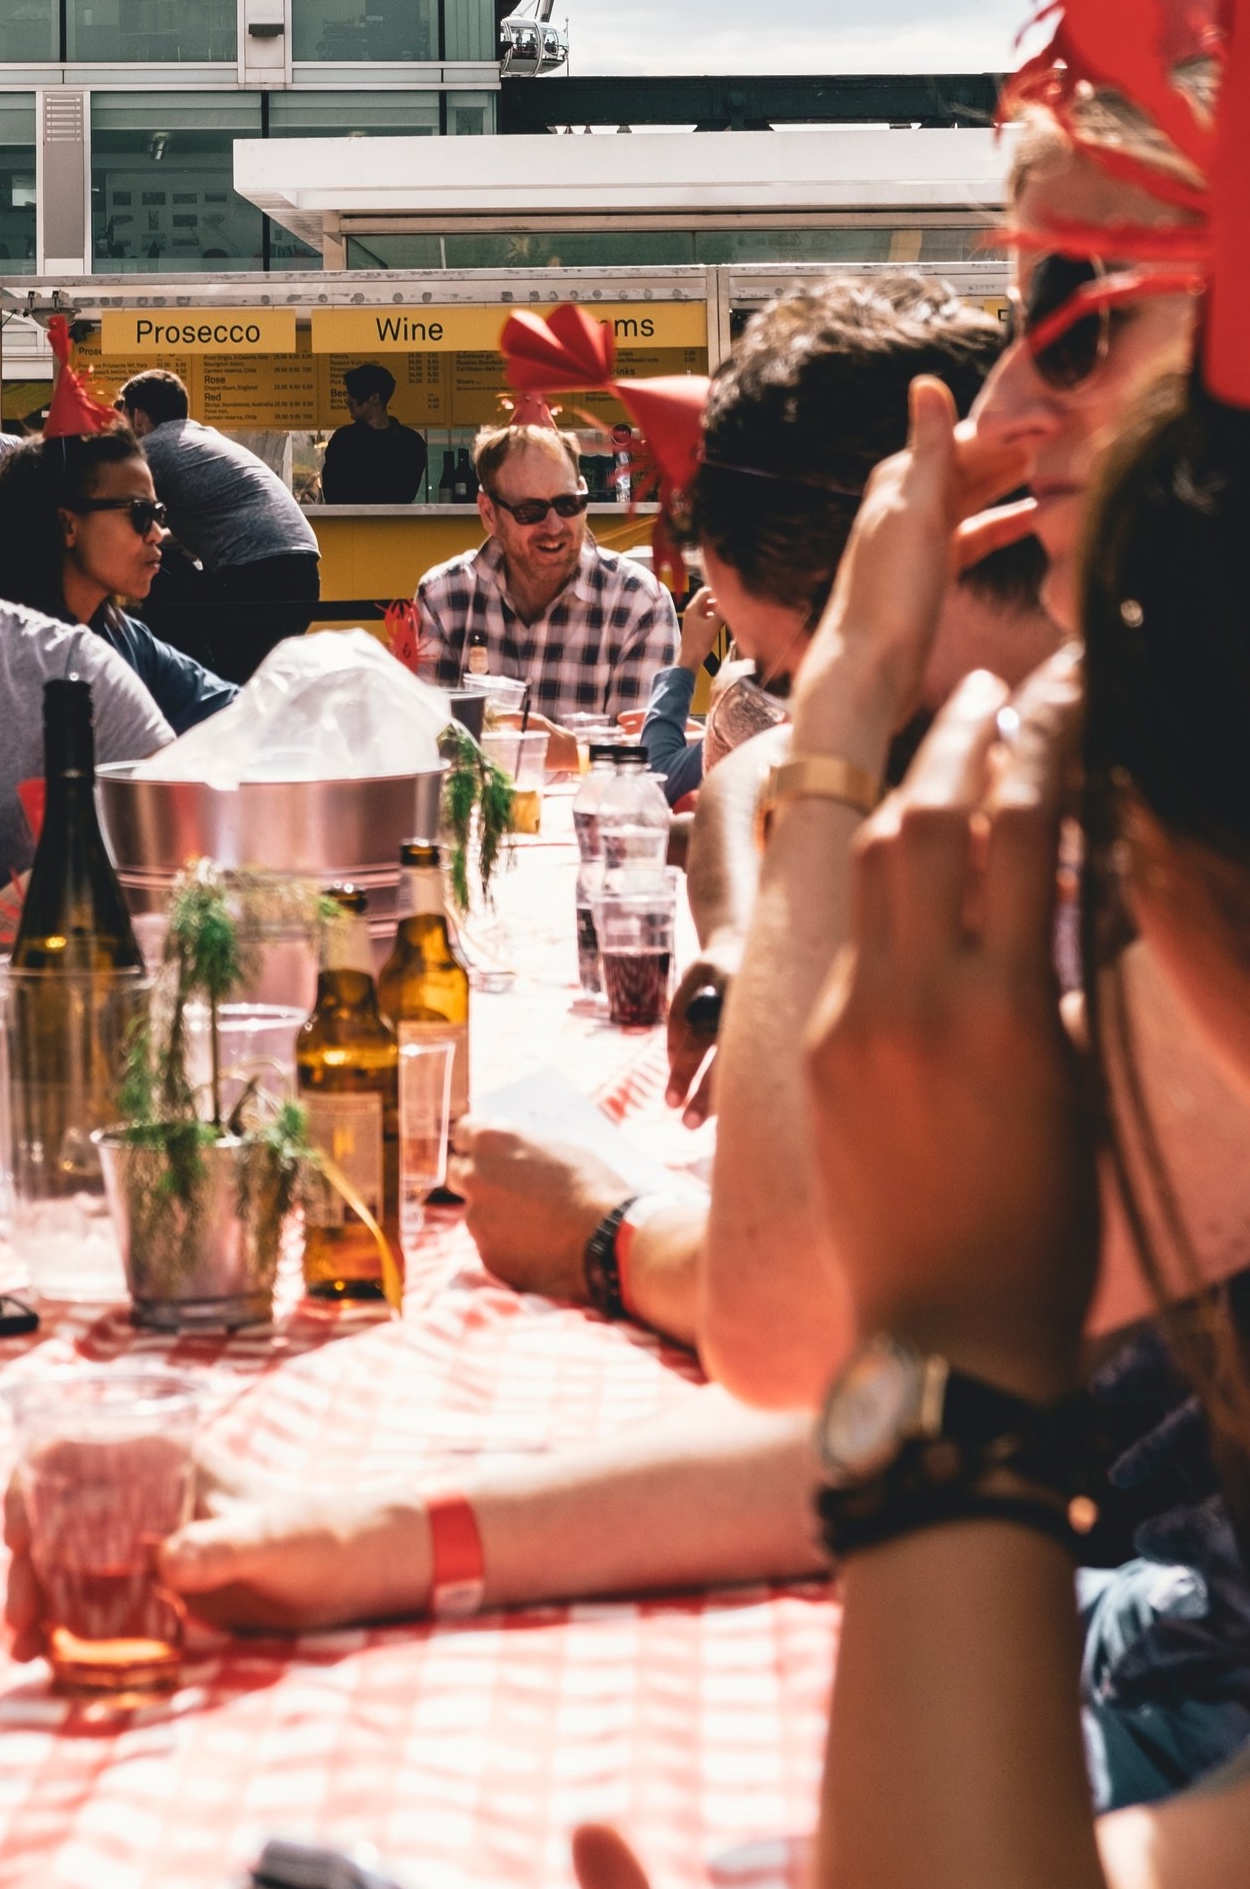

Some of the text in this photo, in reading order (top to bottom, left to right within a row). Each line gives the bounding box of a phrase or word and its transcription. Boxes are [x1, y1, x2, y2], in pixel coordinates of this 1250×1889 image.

[136, 320, 261, 344] Prosecco
[376, 317, 443, 342] Wine
[204, 392, 222, 402] Red
